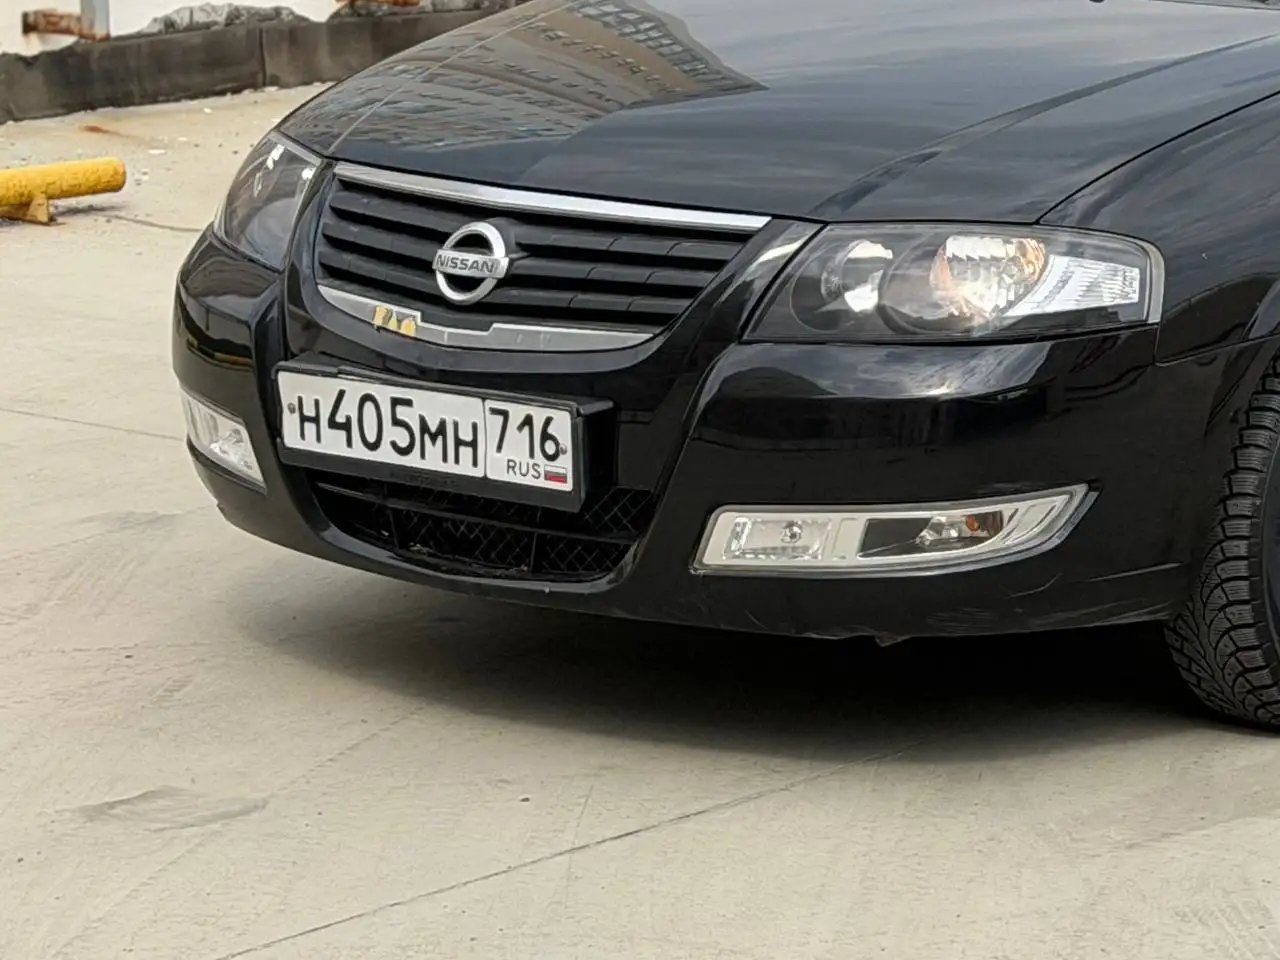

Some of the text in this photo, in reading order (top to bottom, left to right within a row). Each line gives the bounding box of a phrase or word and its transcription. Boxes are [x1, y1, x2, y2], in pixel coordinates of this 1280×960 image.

[436, 254, 494, 273] NISSAN
[489, 407, 560, 462] 716
[507, 459, 541, 479] RUS
